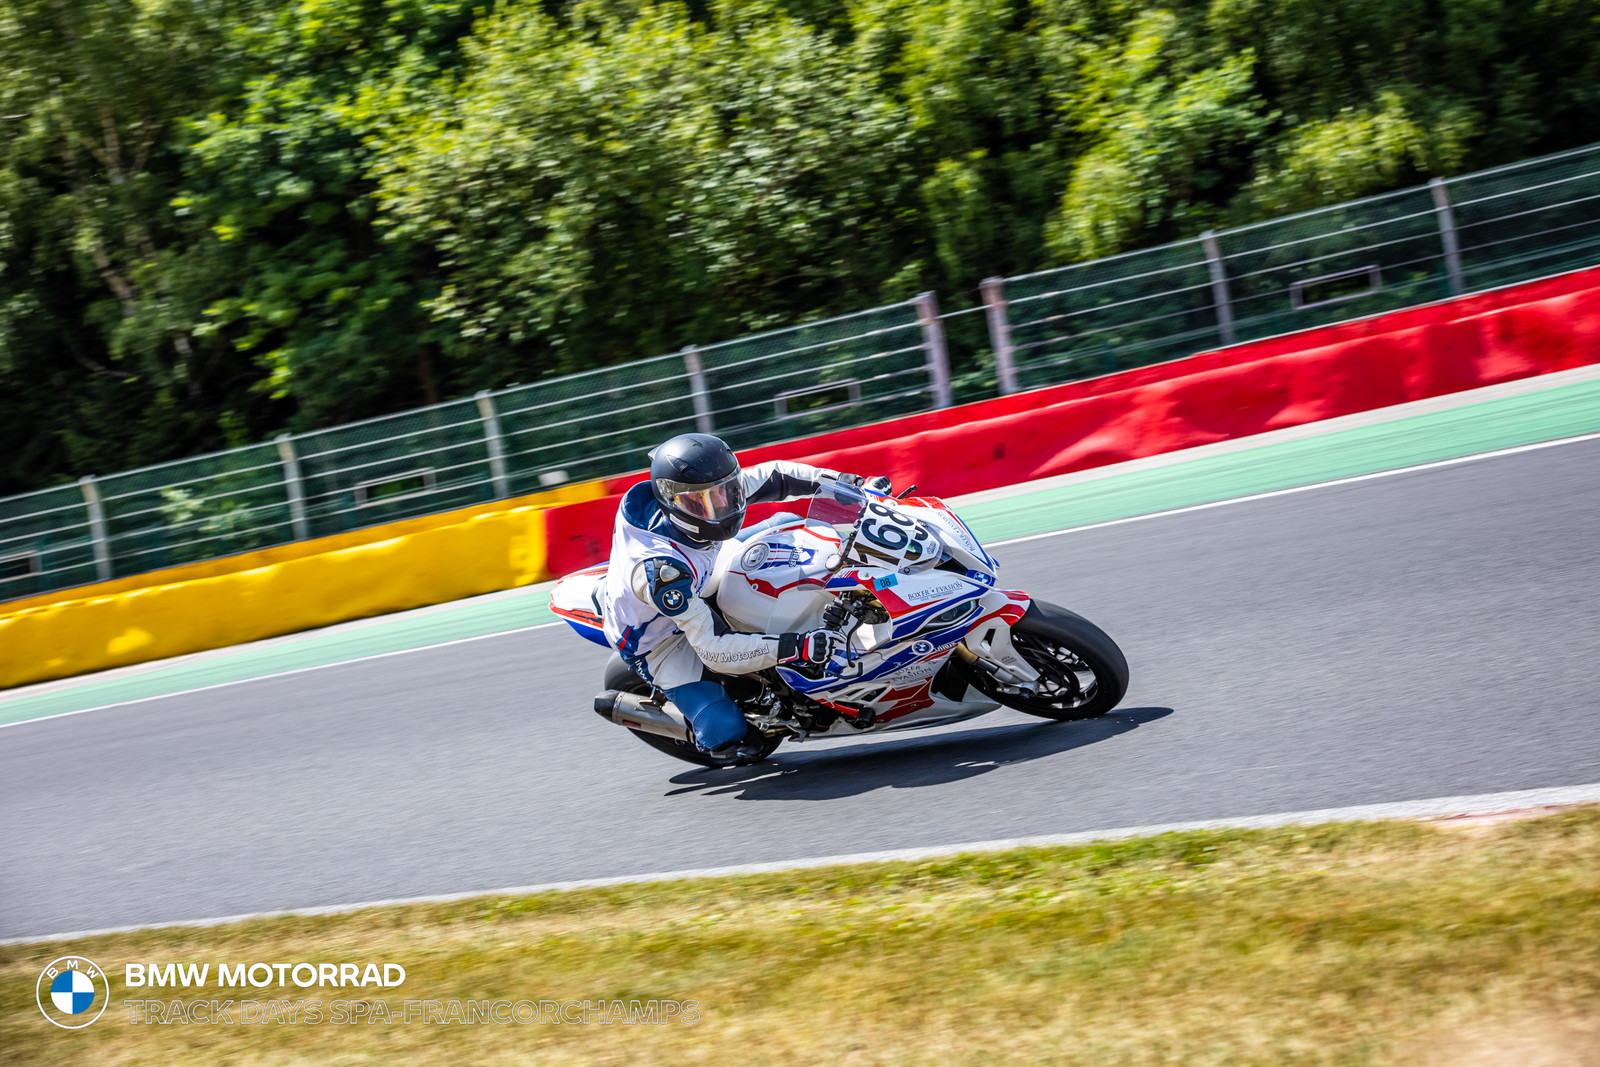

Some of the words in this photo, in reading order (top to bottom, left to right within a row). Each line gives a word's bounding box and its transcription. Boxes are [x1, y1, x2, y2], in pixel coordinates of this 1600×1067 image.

[853, 502, 915, 566] 168
[907, 589, 930, 600] BOXER
[936, 581, 963, 593] EVASION
[720, 644, 770, 664] Motorrad
[891, 667, 932, 682] EVASION
